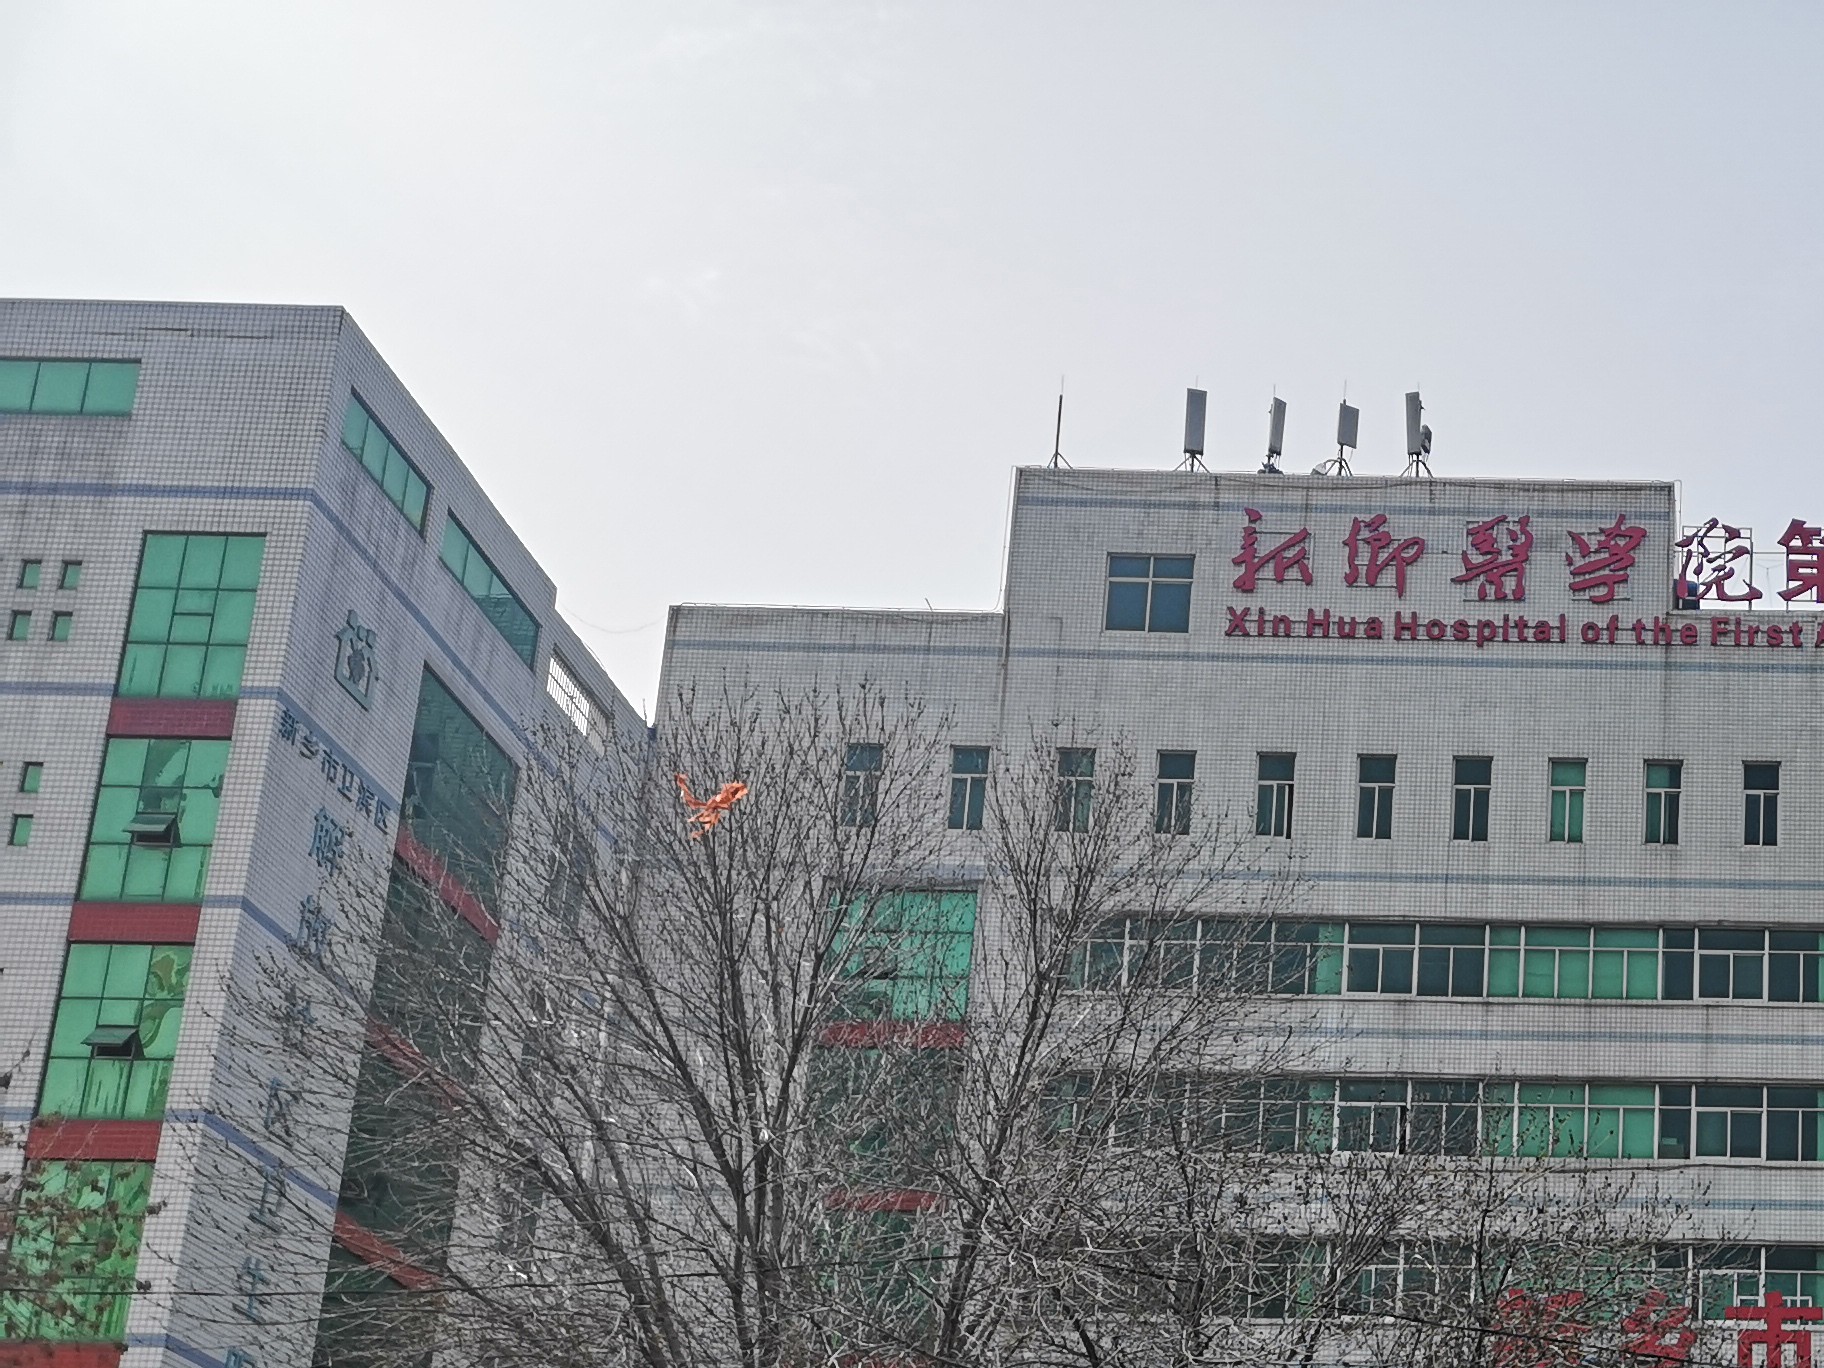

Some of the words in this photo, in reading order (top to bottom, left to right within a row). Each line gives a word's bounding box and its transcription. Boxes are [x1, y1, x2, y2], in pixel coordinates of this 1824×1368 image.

[1226, 607, 1292, 637] Xin
[1306, 608, 1383, 639] Hua
[1394, 611, 1566, 647] Hospital
[1581, 615, 1618, 644] of
[1633, 616, 1698, 645] the
[1710, 616, 1803, 647] First
